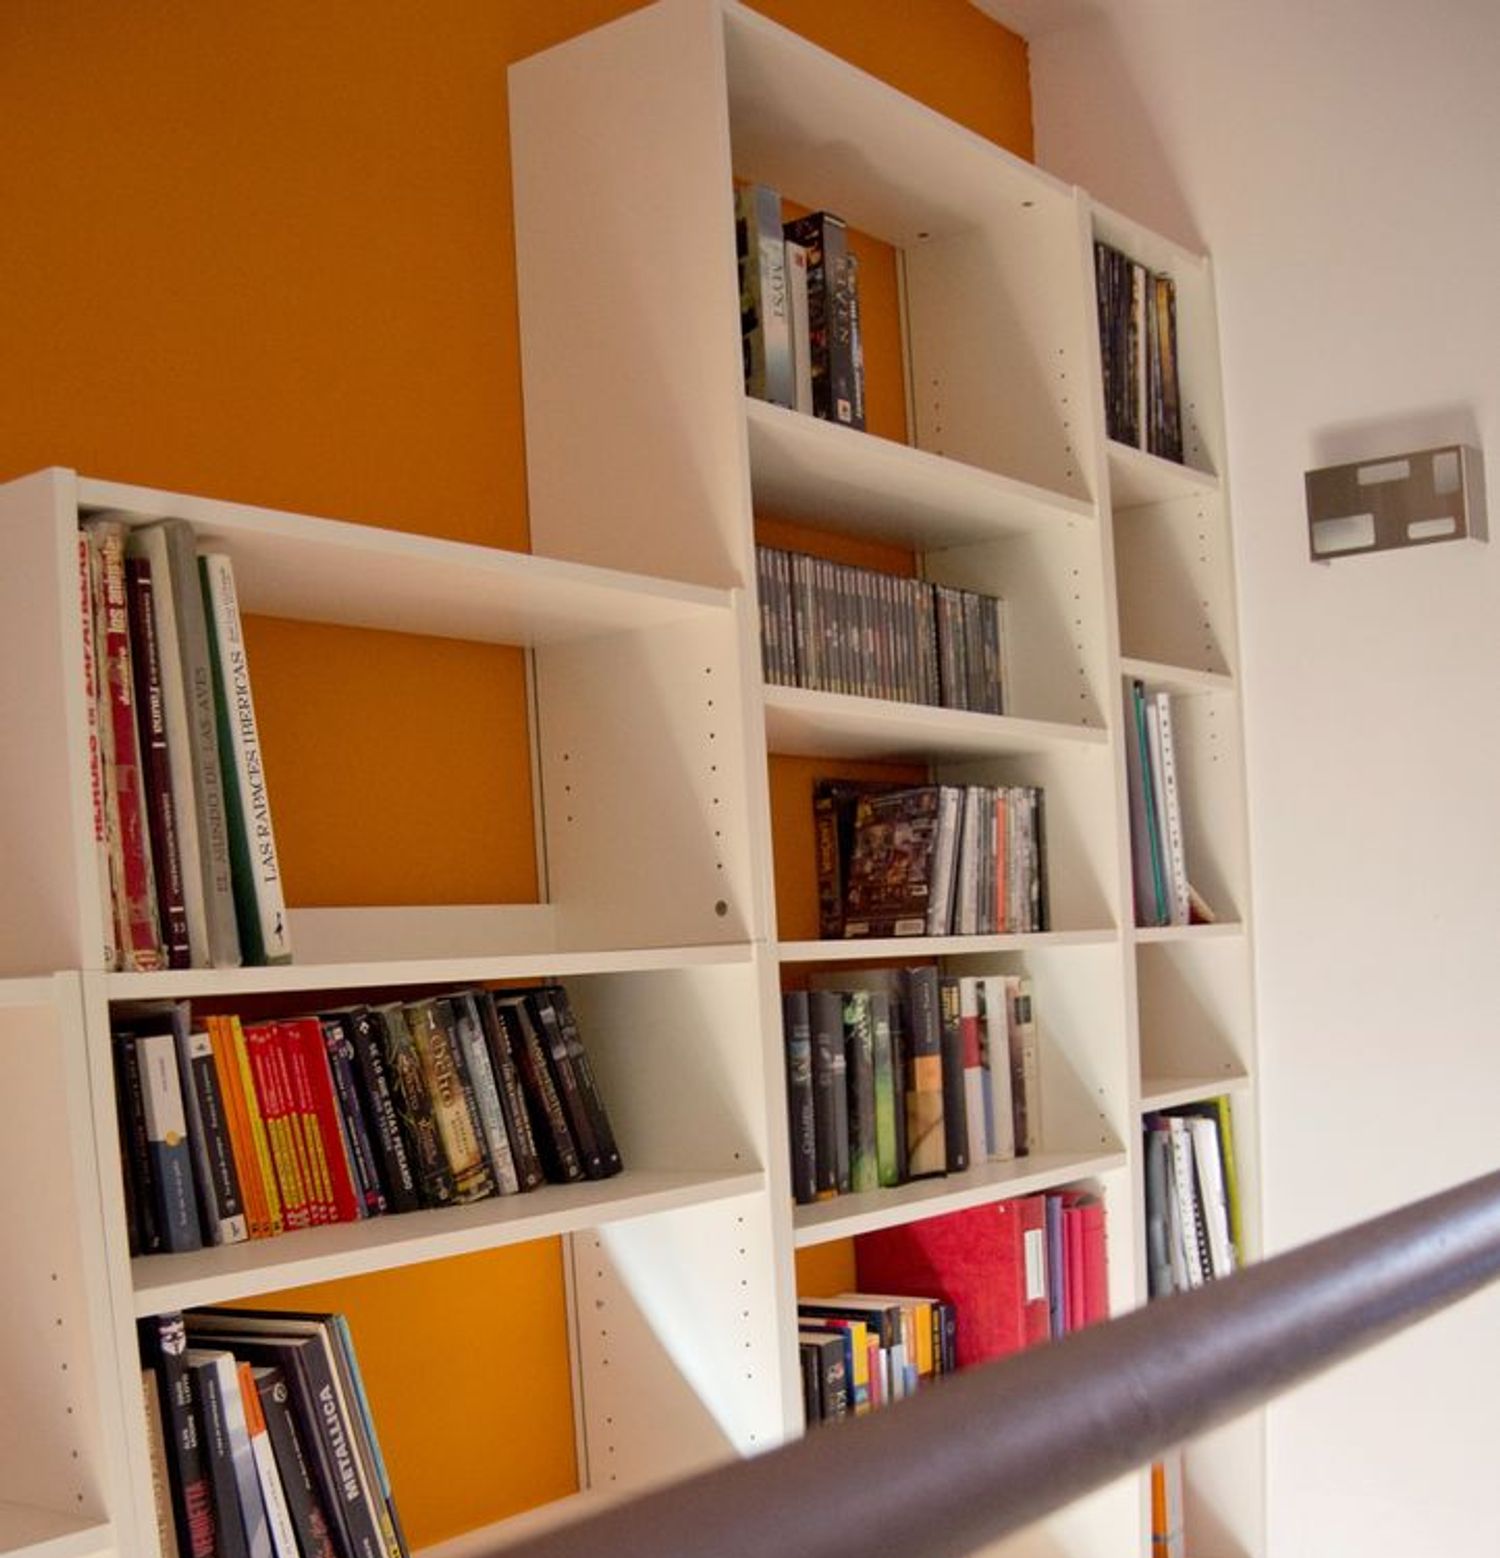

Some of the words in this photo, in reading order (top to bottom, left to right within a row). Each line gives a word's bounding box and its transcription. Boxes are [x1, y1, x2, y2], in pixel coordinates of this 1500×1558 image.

[231, 650, 256, 744] IBERICAS
[245, 749, 271, 838] RAPACES
[261, 843, 277, 883] LAS
[319, 1384, 361, 1502] METALLICA
